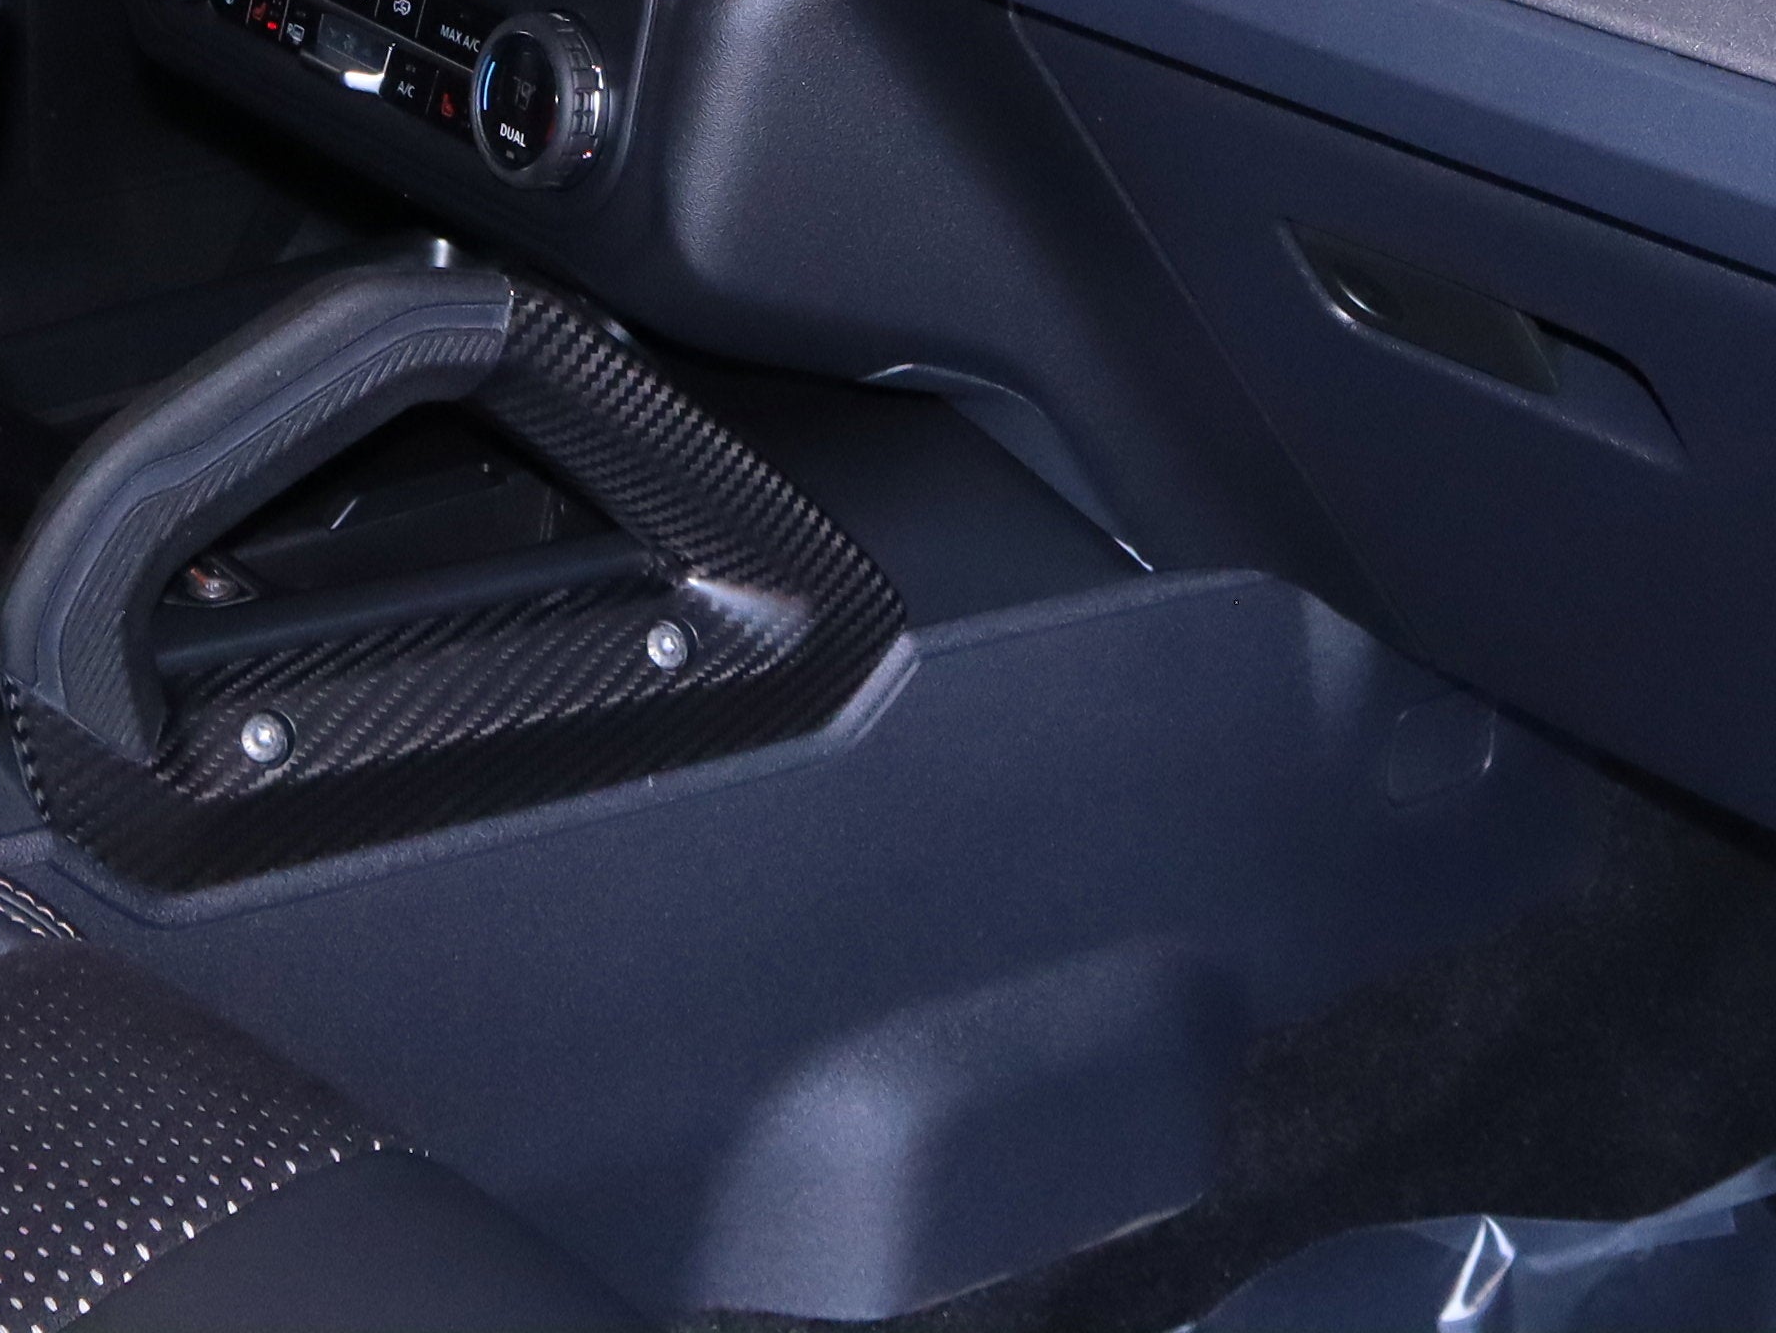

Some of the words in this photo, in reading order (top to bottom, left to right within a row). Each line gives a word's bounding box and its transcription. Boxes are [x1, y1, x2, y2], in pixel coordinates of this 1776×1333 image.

[440, 24, 462, 46] MAX
[462, 34, 480, 54] A/C
[396, 80, 416, 99] A/C
[499, 122, 527, 148] DUAL
